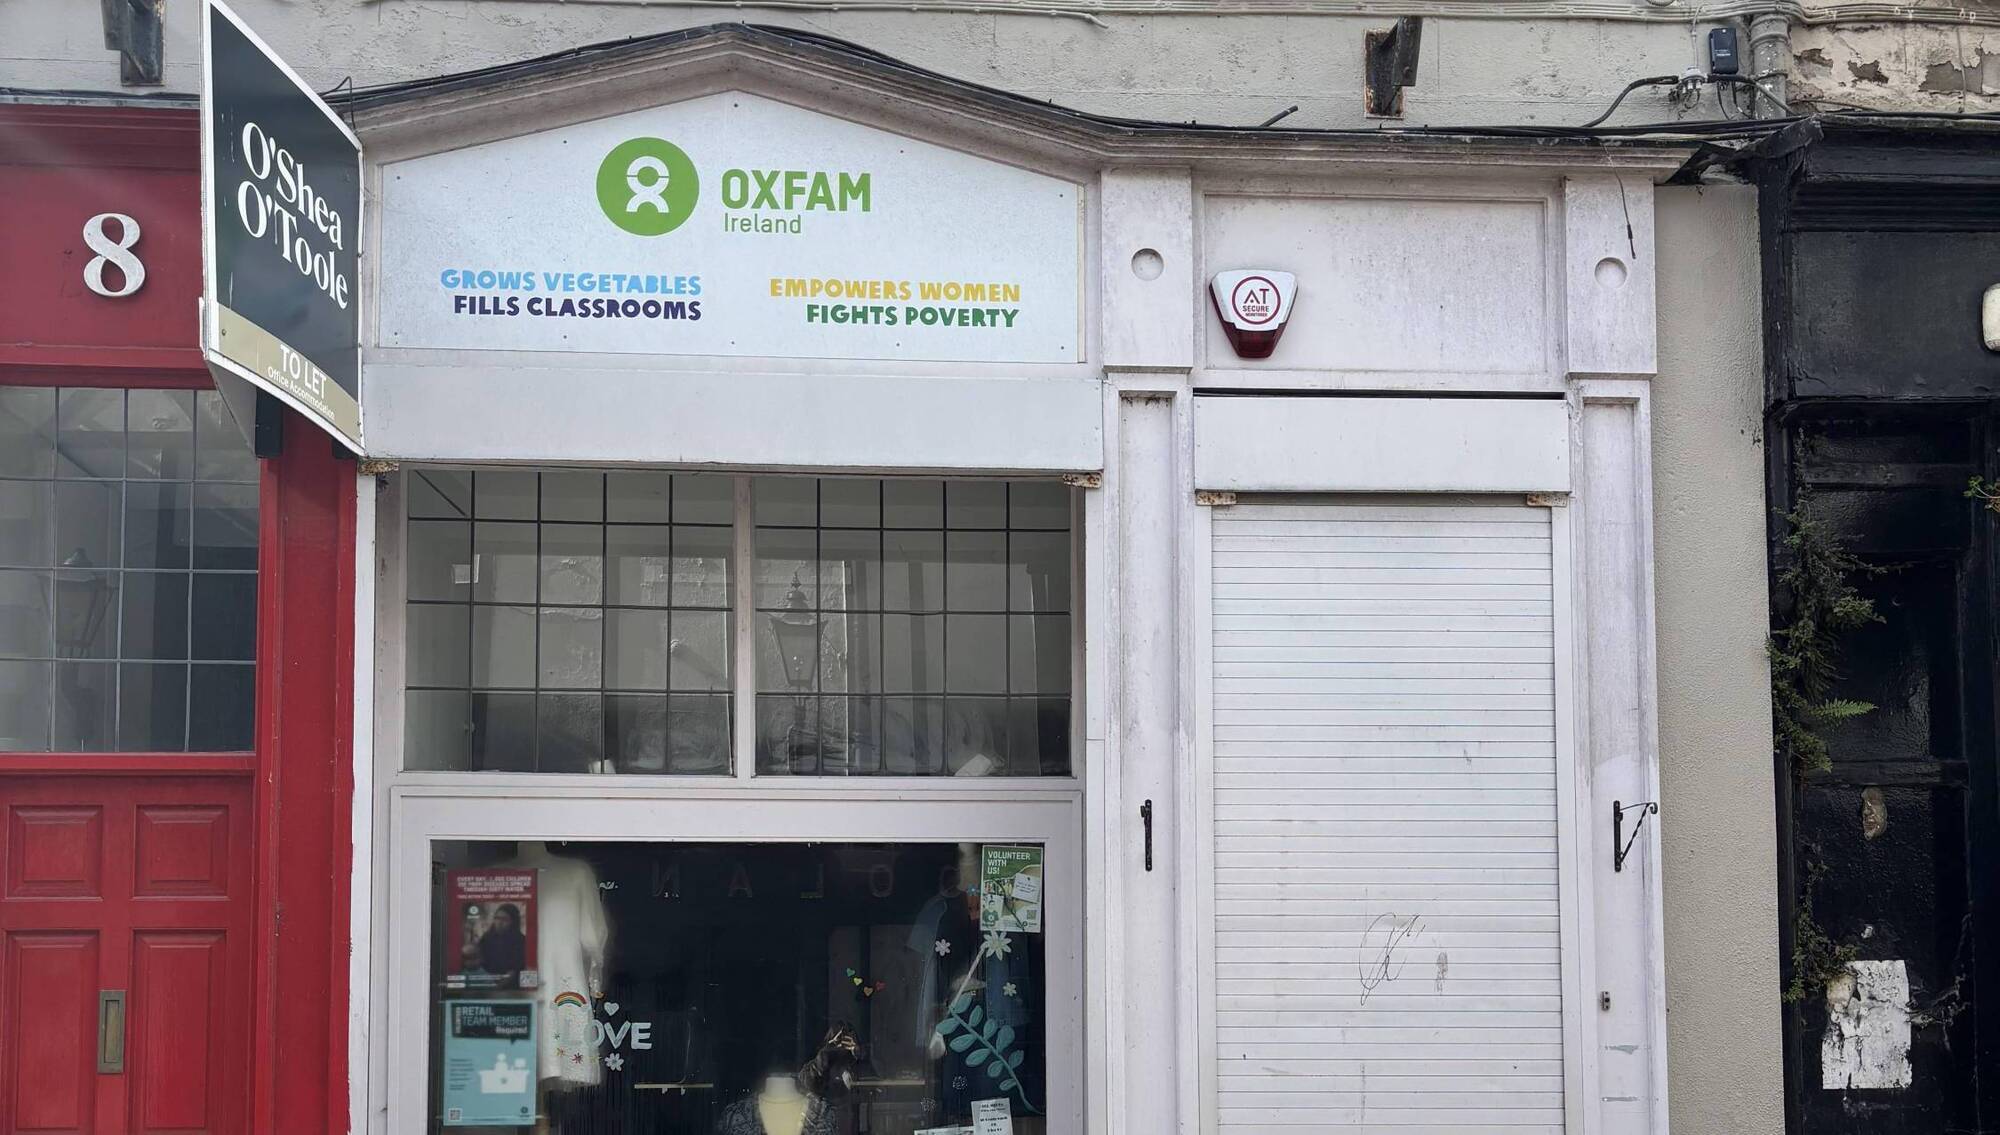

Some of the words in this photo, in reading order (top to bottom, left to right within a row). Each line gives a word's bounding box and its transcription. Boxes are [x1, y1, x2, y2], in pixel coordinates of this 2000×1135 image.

[242, 122, 343, 250] O'Shea
[721, 168, 871, 212] OXFAM
[724, 212, 802, 234] Ireland
[83, 212, 145, 297] 8
[237, 180, 348, 309] O'Toole
[440, 269, 536, 292] GROWS
[543, 271, 702, 297] VEGETABLES
[769, 278, 912, 301] EMPOWERS
[919, 282, 1020, 303] WOMEN
[453, 295, 520, 317] FILLS
[526, 296, 702, 321] CLASSROOMS
[1243, 288, 1270, 304] AT
[806, 303, 898, 326] FIGHTS
[905, 306, 1020, 328] POVERTY
[280, 344, 301, 380] TO
[304, 360, 327, 400] LET
[267, 366, 289, 388] Office
[290, 380, 335, 420] Accommodation
[988, 851, 1031, 860] VOLUNTEER
[988, 859, 1007, 867] WITH
[987, 867, 1000, 875] US!
[462, 1006, 494, 1016] RETAIL
[462, 1016, 485, 1026] TEAM
[489, 1016, 528, 1026] MEMBER
